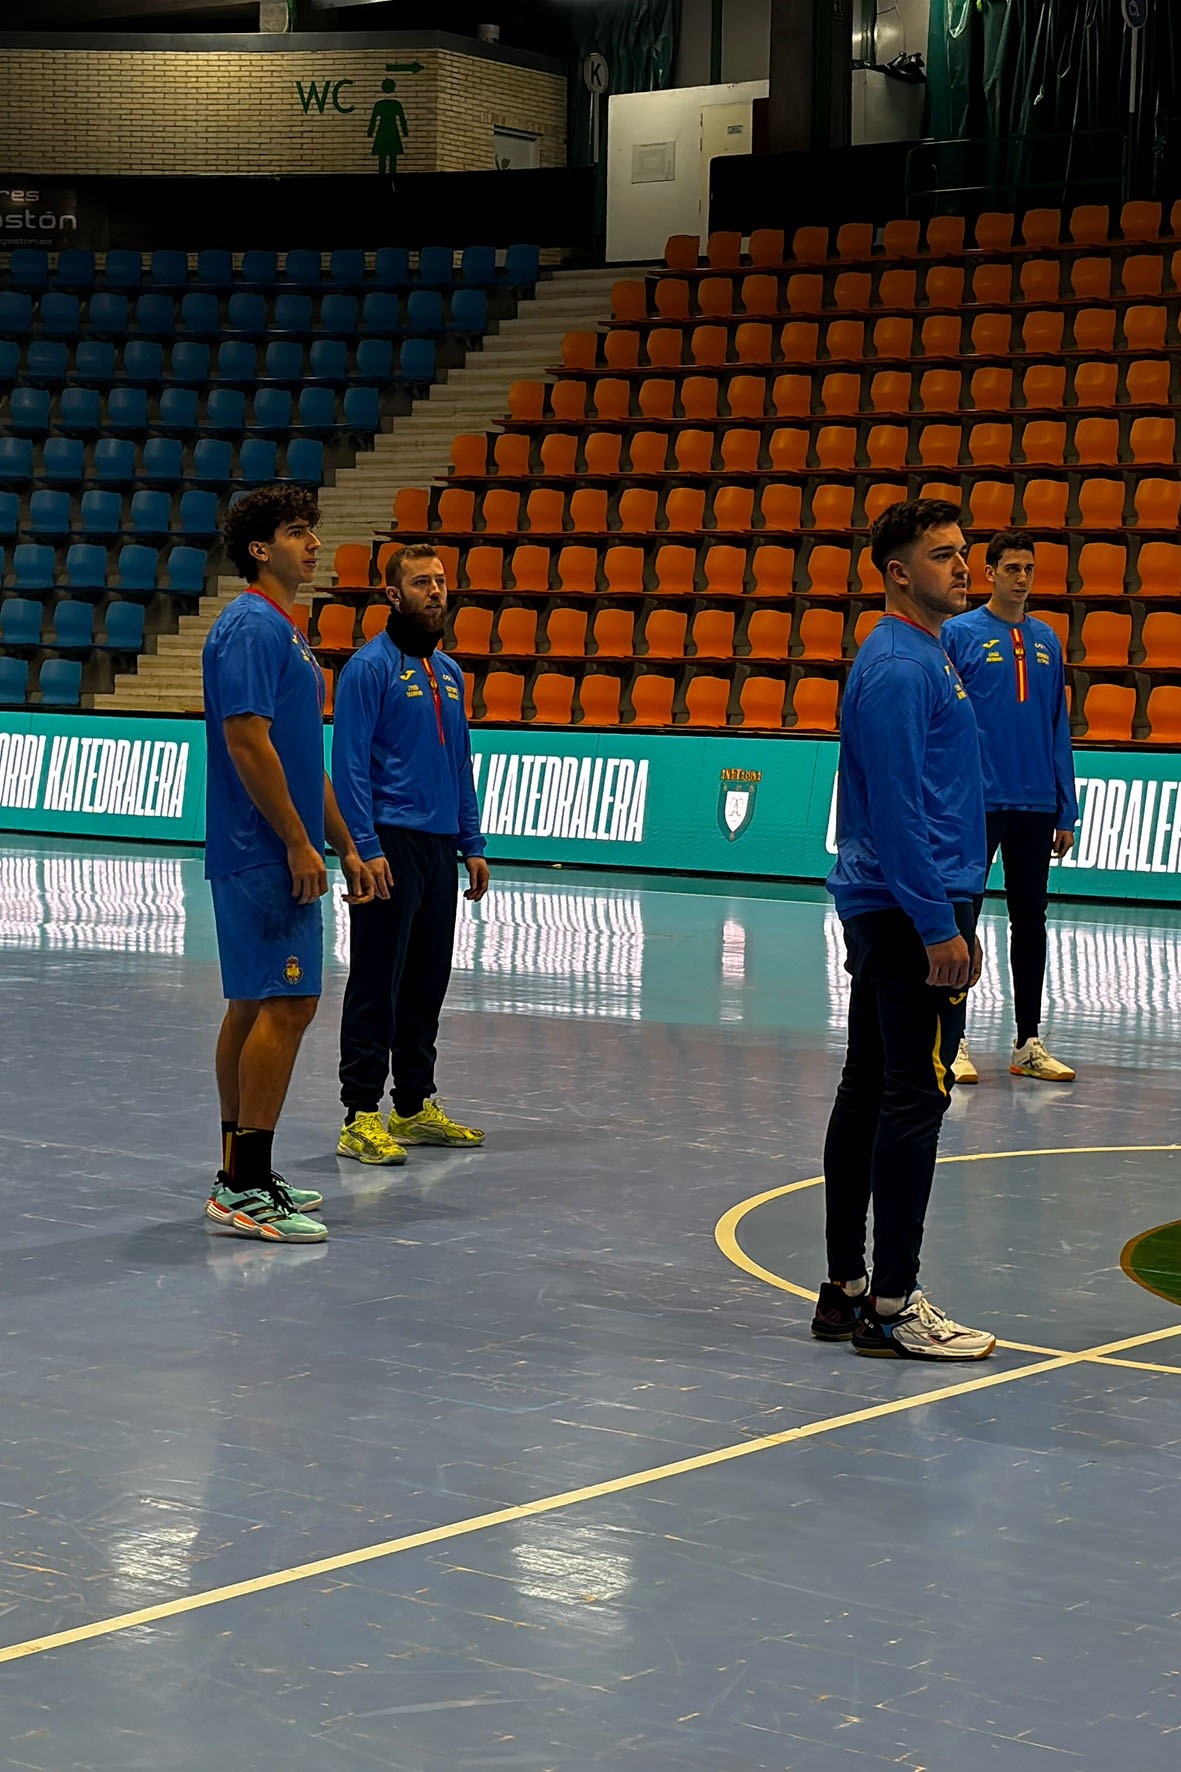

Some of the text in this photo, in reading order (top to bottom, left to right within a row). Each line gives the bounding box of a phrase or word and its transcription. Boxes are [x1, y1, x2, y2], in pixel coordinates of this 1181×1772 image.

[590, 60, 602, 87] K
[295, 79, 356, 114] WC
[0, 208, 78, 230] stón
[43, 735, 190, 818] KATEDRALERA
[480, 753, 649, 842] KATEDRALERA
